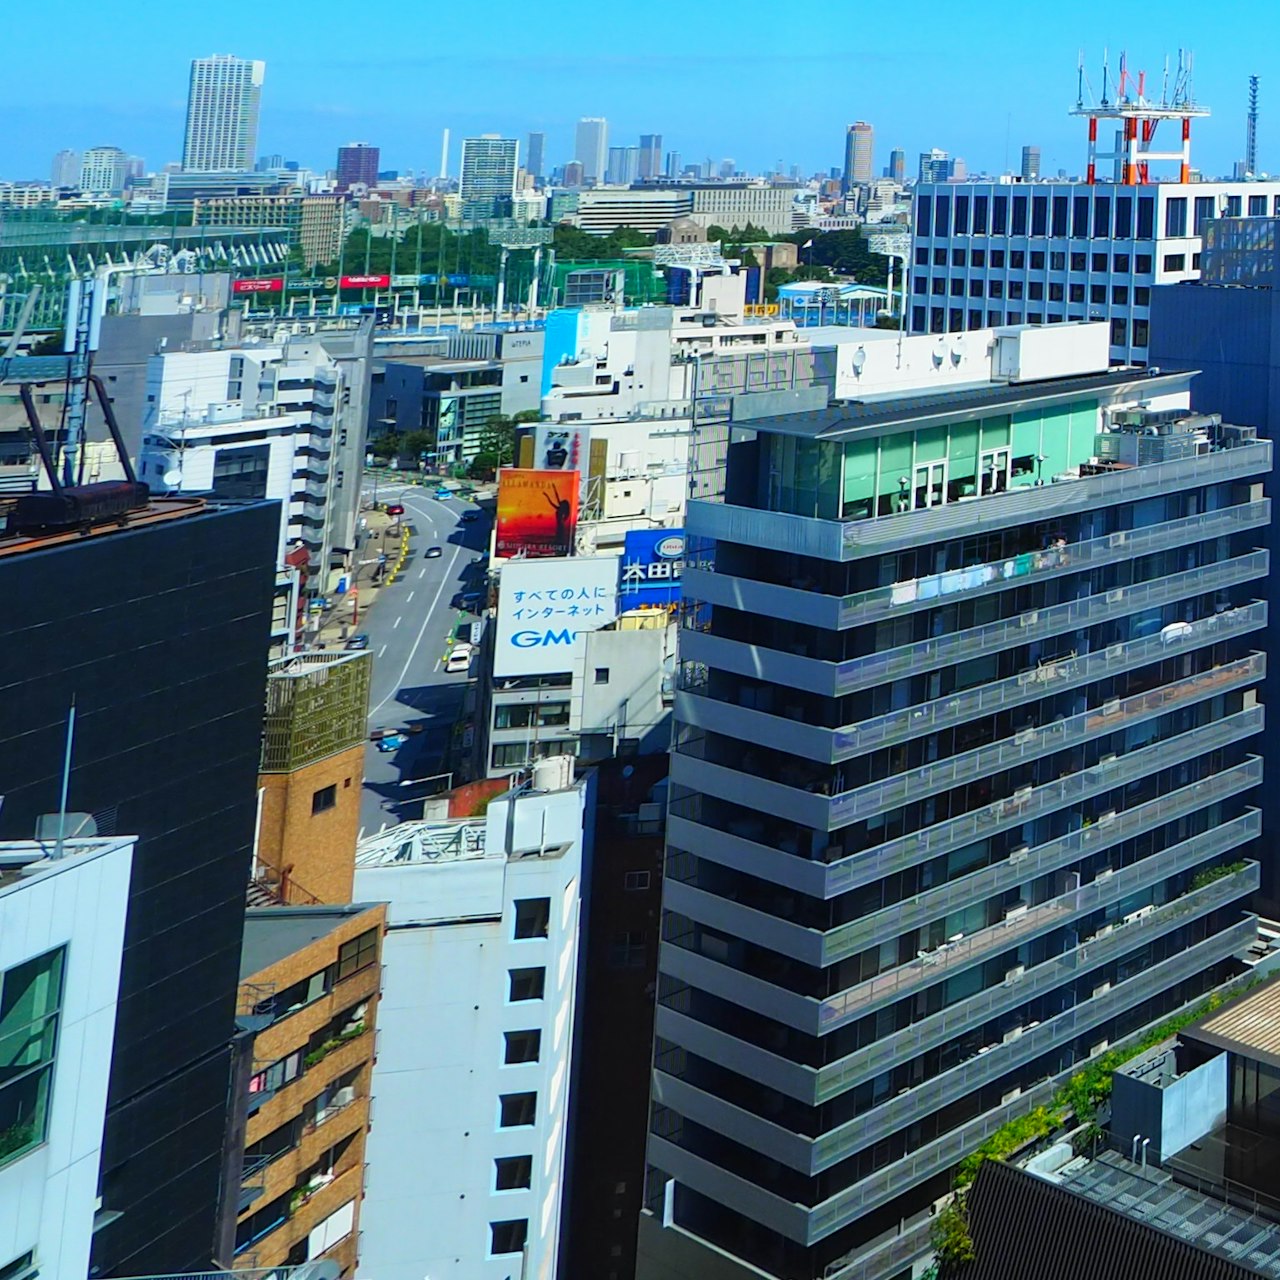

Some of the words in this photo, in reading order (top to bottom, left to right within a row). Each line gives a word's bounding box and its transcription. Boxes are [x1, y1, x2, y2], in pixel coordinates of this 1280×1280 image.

[513, 586, 606, 603] すべての人に
[512, 604, 605, 620] インターネット
[510, 628, 577, 648] GM
